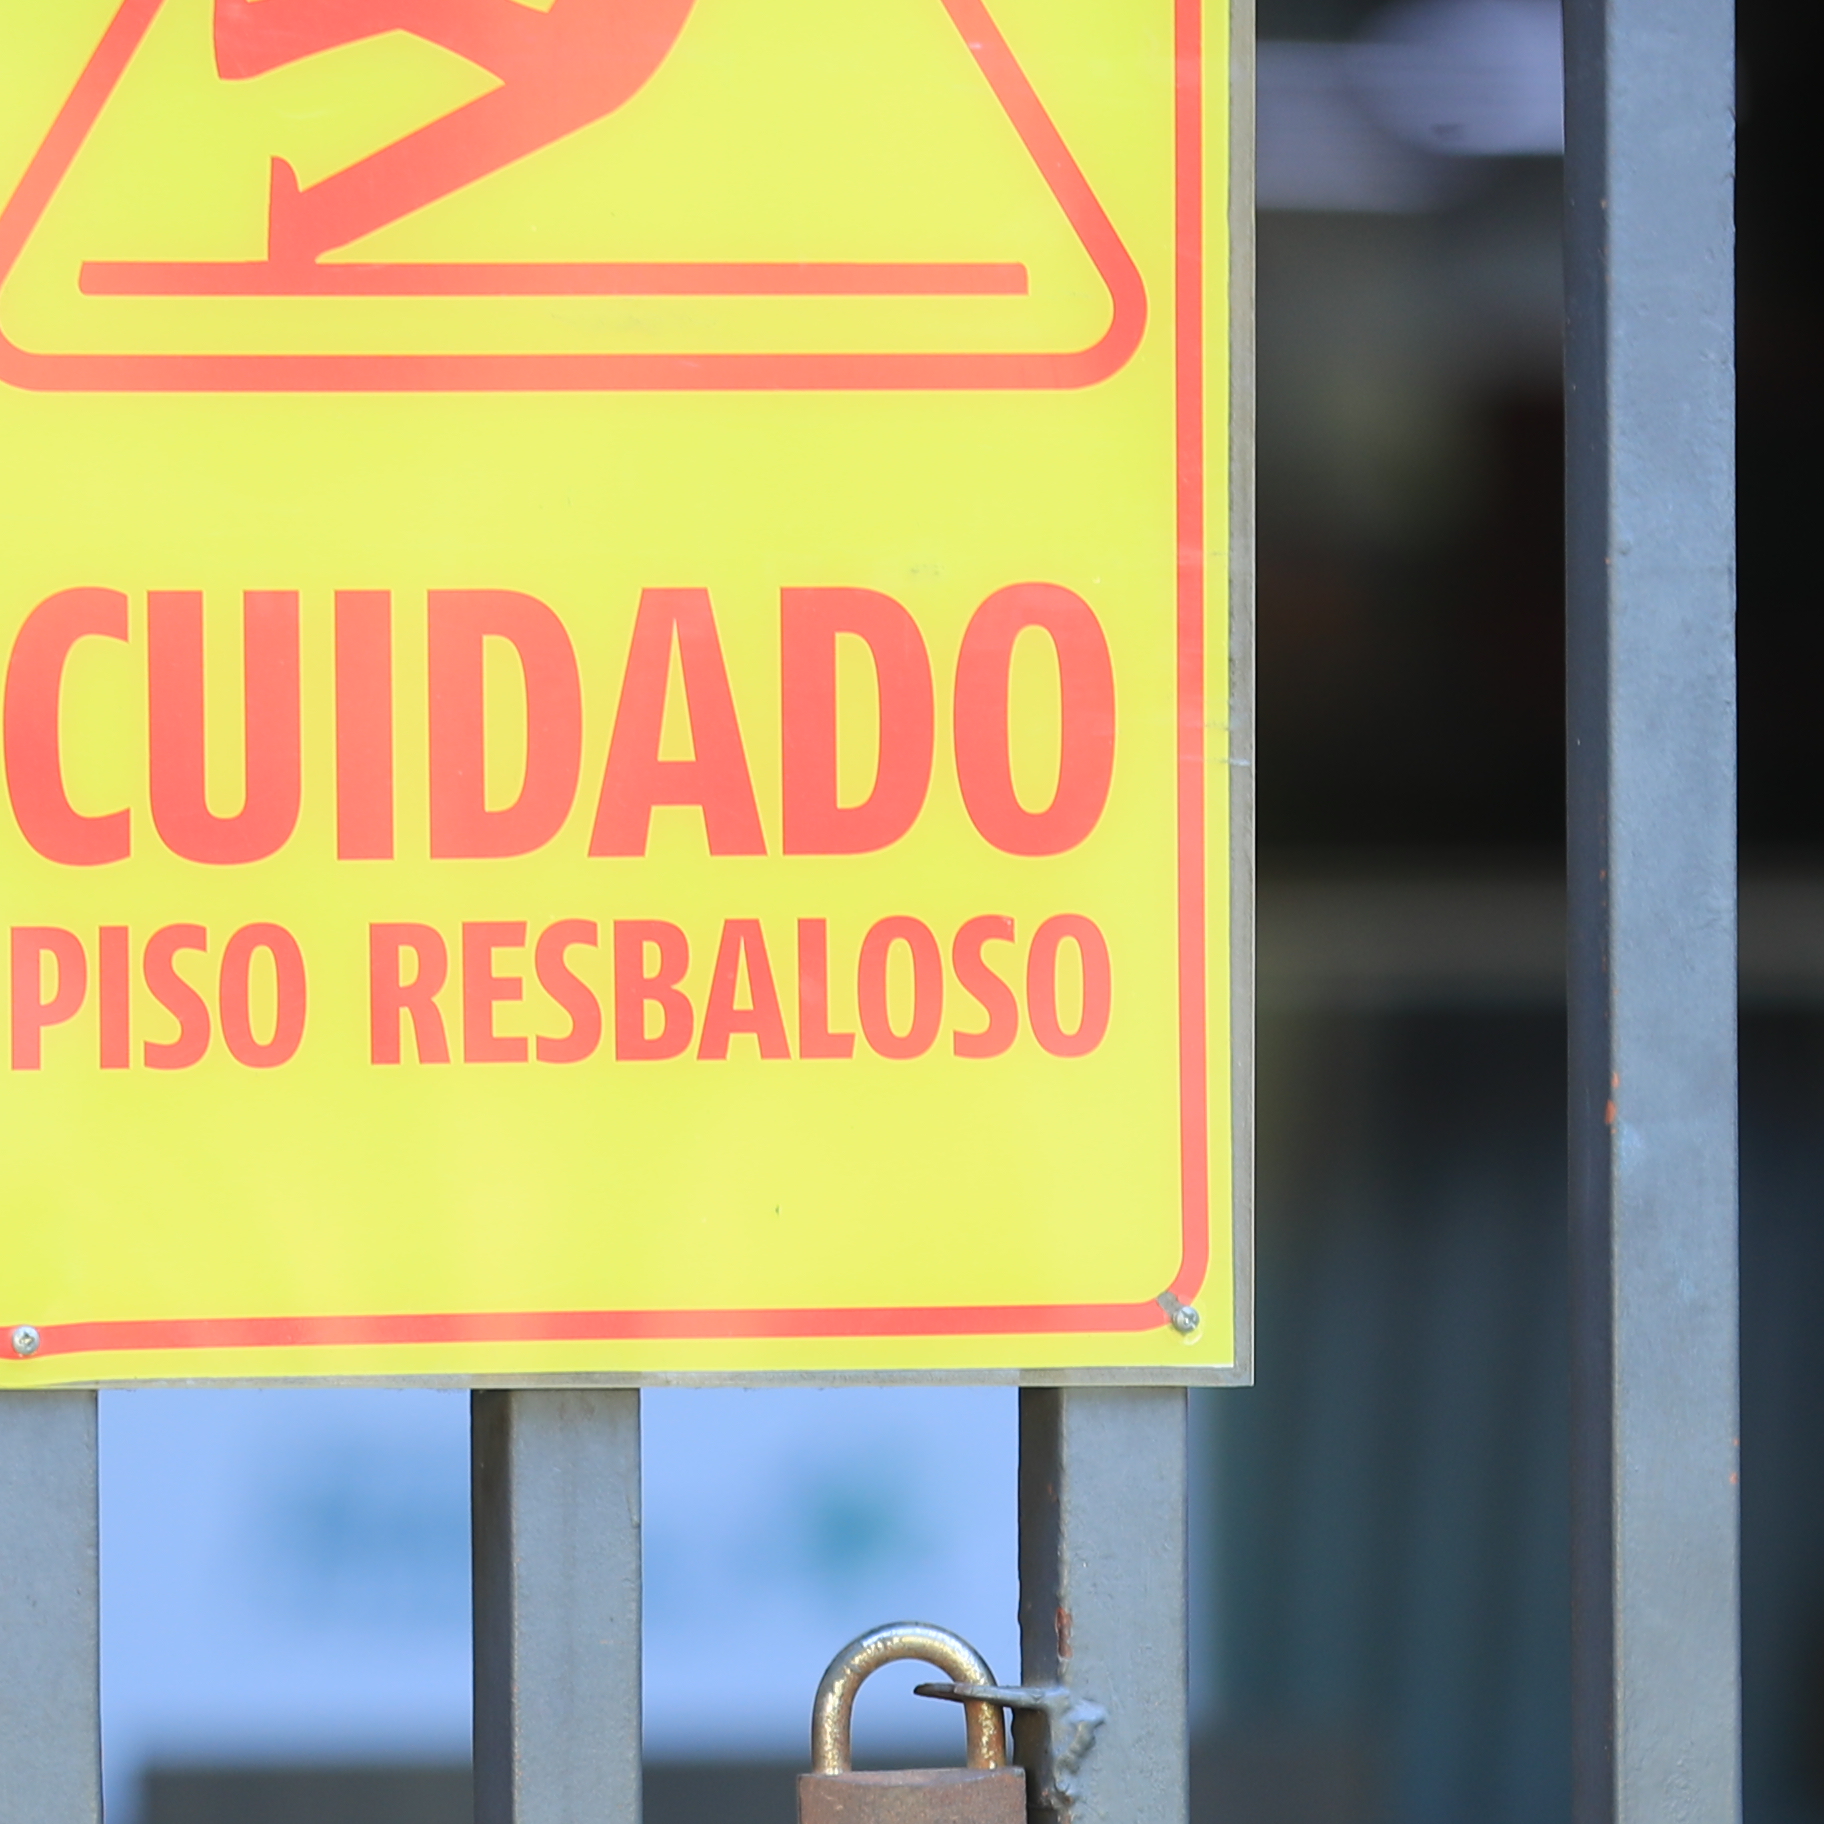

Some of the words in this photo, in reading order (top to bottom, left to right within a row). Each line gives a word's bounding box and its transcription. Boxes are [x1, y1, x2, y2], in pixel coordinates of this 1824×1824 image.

[2, 583, 1115, 866] CUIDADO
[10, 923, 307, 1070] PISO
[369, 914, 1112, 1065] RESBALOSO
